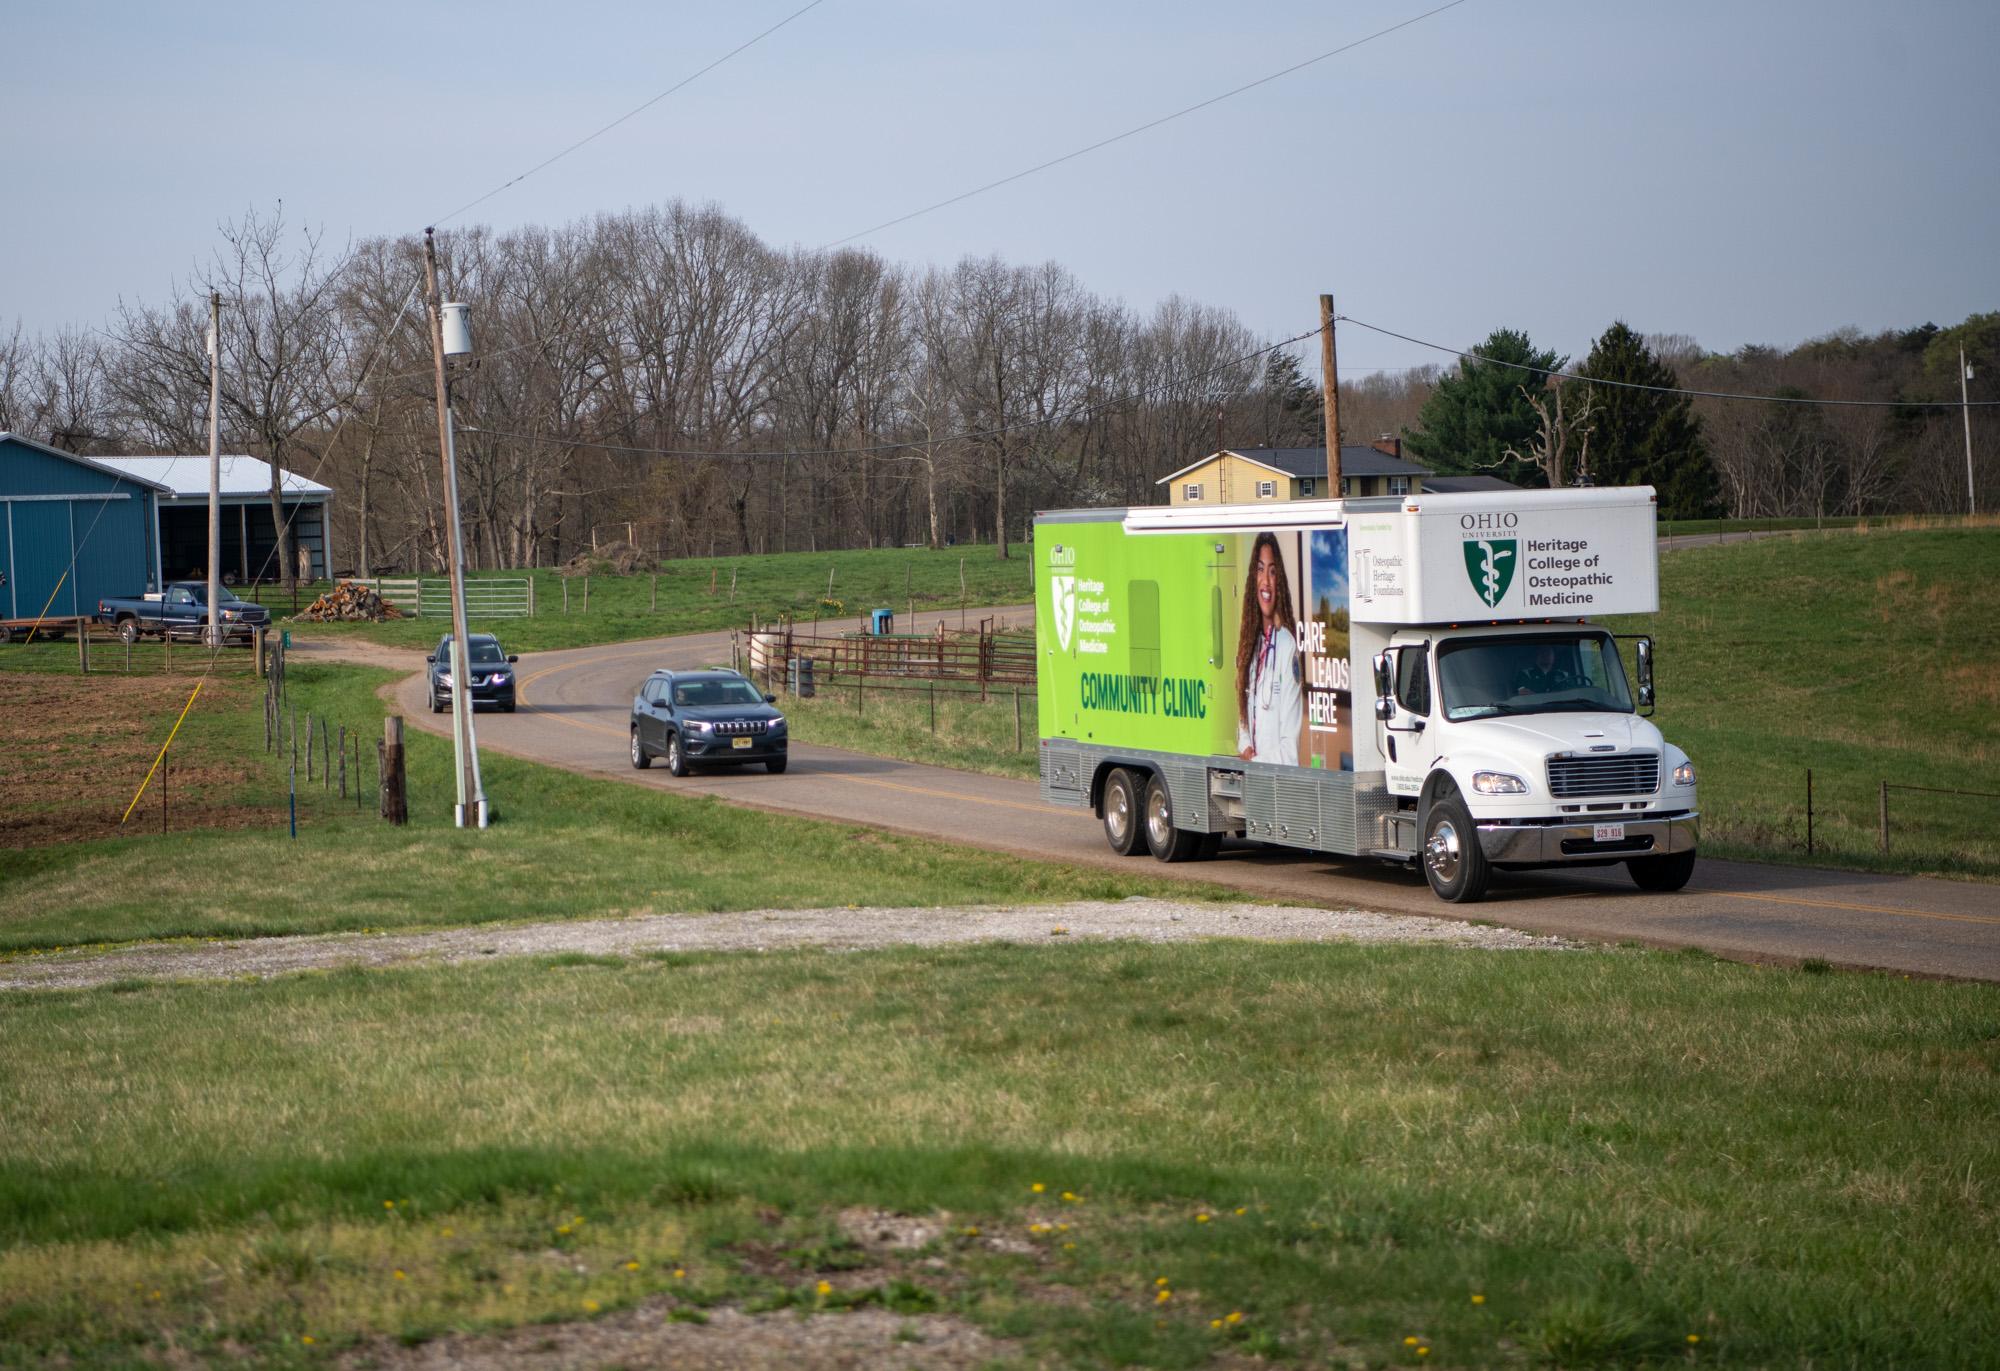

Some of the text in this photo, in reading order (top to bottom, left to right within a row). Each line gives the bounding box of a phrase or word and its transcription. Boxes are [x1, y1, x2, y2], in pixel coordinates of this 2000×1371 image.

[1460, 512, 1518, 530] OHIO
[1462, 530, 1518, 539] UNIVERSITY
[1528, 539, 1588, 553] Heritage
[1528, 555, 1600, 572] College of
[1078, 578, 1104, 595] Heritage
[1529, 573, 1613, 589] Osteopathic
[1530, 592, 1594, 606] Medicine
[1296, 621, 1327, 653] CARE
[1312, 656, 1349, 690] LEADS
[1081, 672, 1206, 719] COMMUNITY CLINIC
[1308, 691, 1337, 724] HERE
